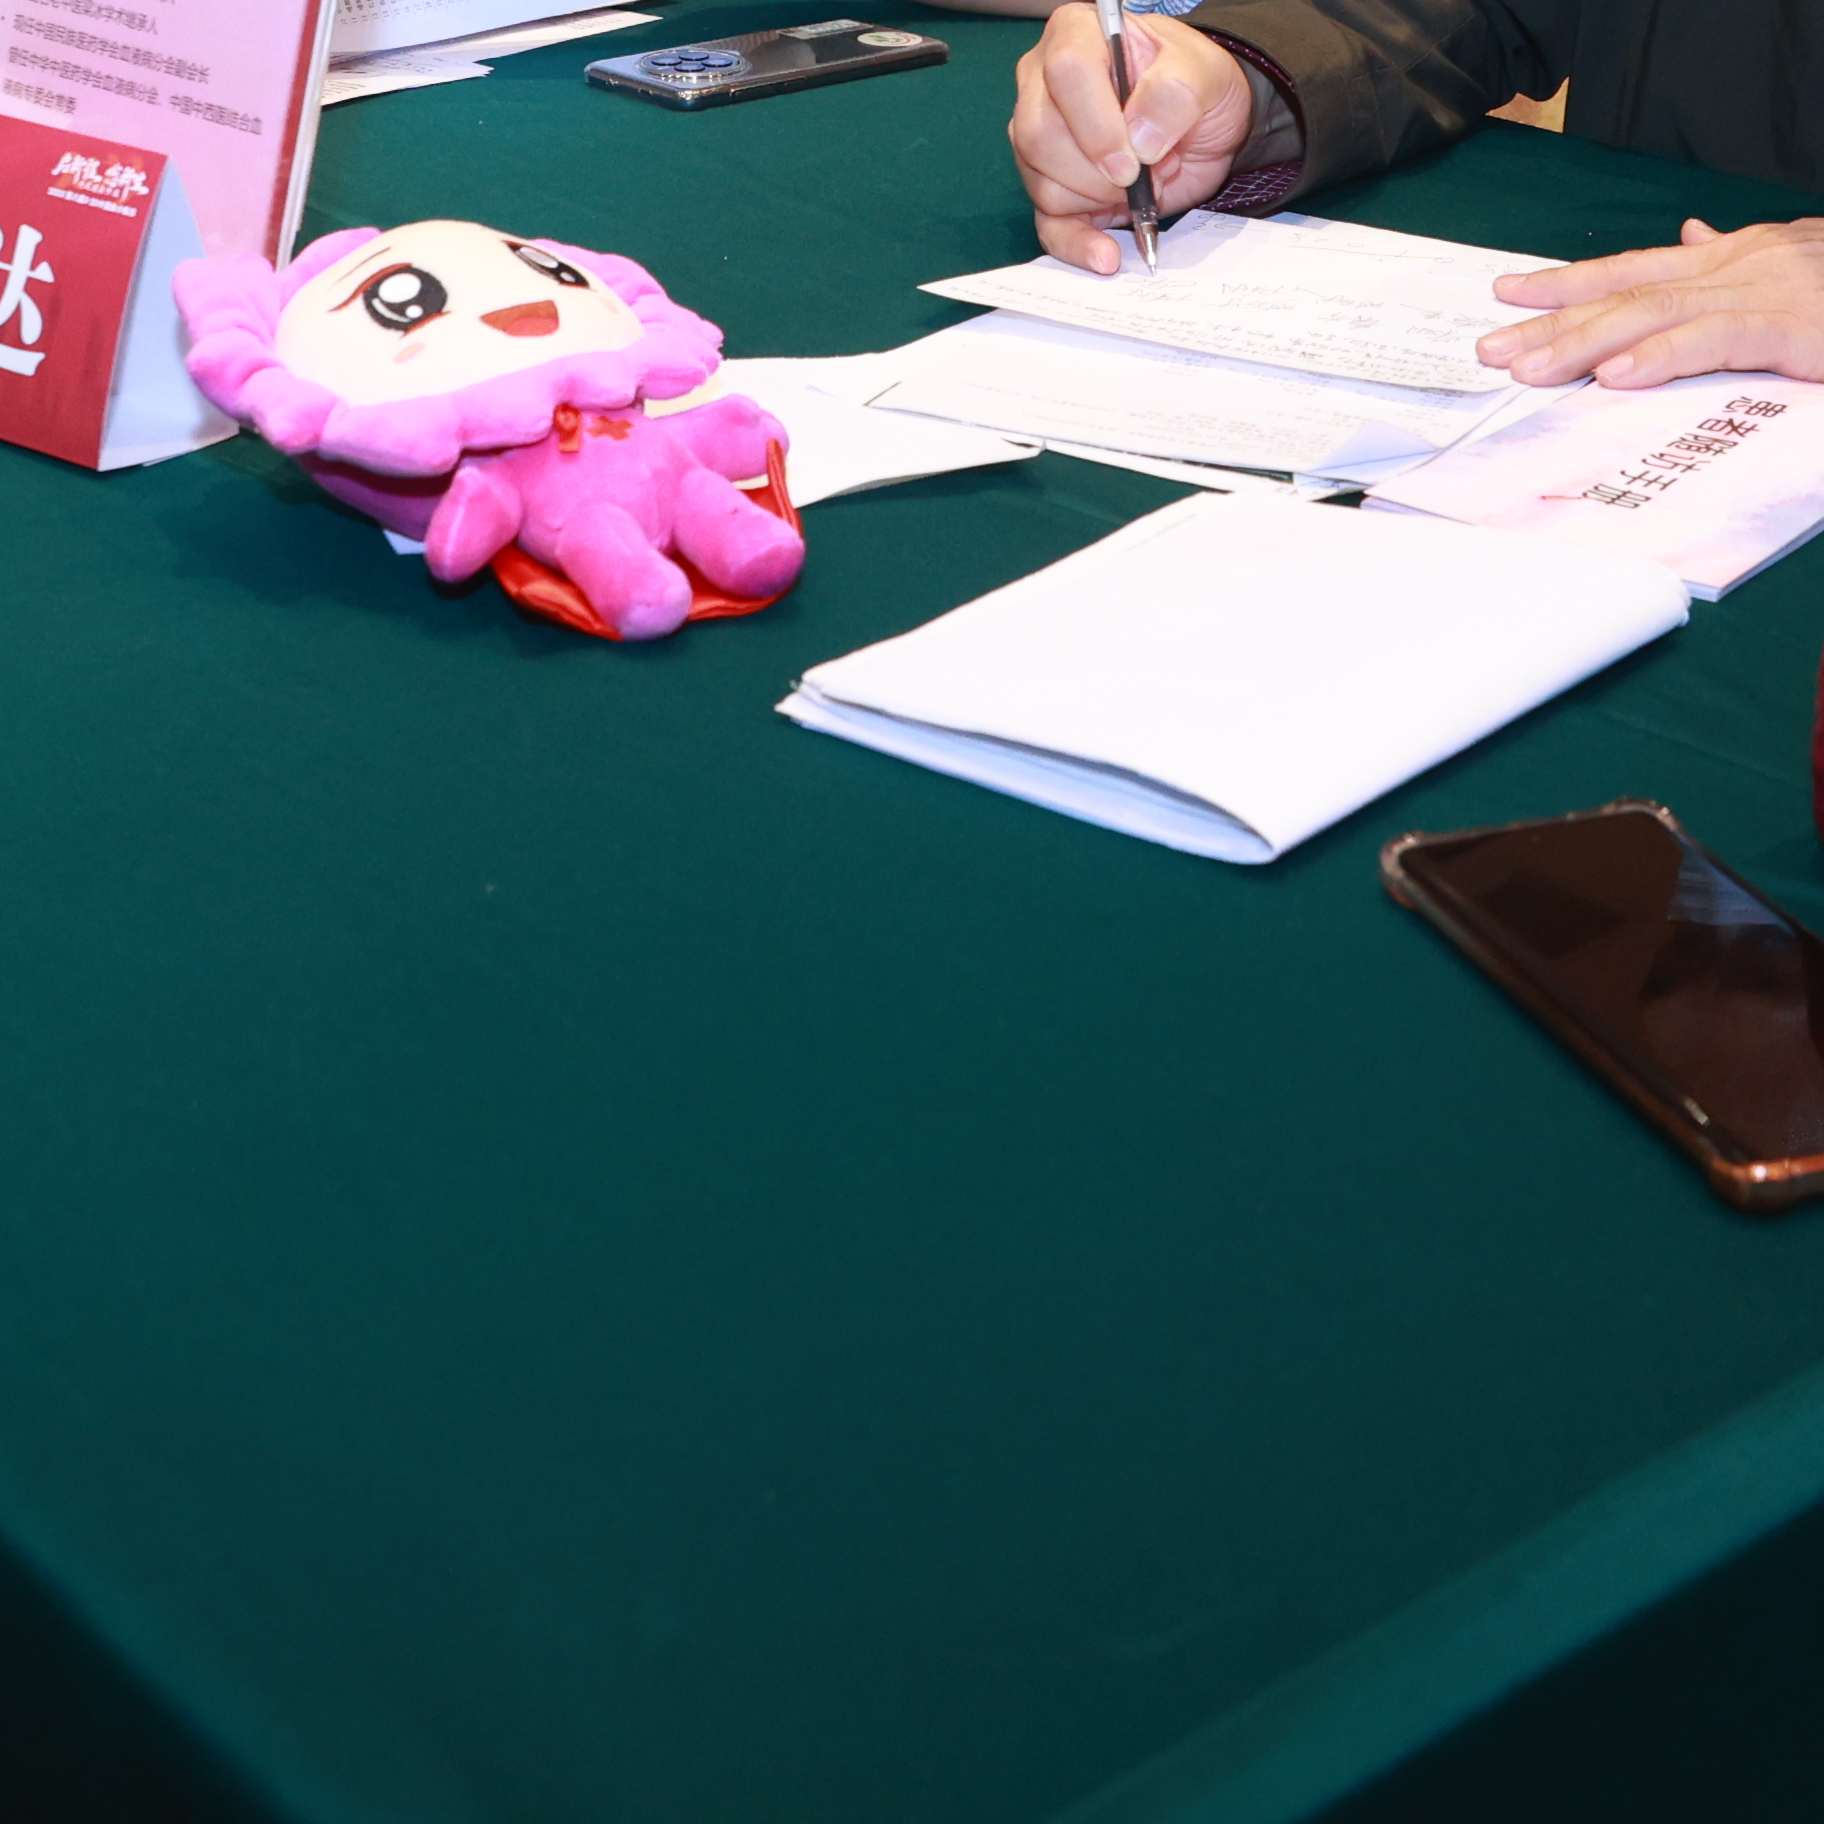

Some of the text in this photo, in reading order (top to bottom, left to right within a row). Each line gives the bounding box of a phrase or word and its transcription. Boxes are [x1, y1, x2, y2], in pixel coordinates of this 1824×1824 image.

[1581, 395, 1789, 510] 患者随访手册
